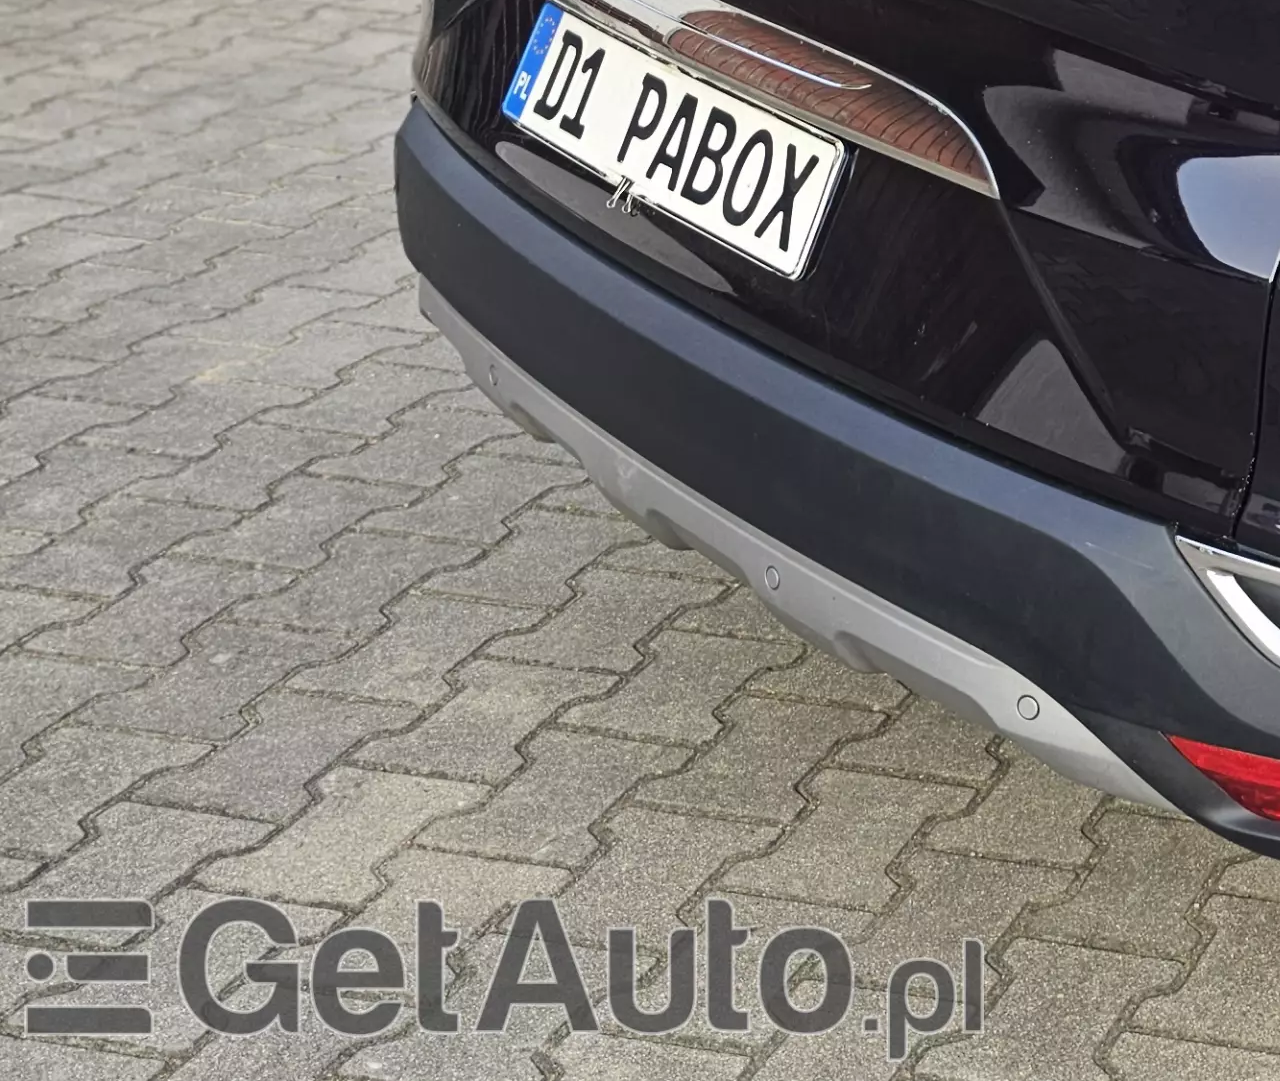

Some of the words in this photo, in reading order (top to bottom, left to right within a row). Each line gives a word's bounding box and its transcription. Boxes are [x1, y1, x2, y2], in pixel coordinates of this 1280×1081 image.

[513, 71, 530, 101] PL
[532, 29, 606, 140] D1
[616, 72, 820, 253] PABOX
